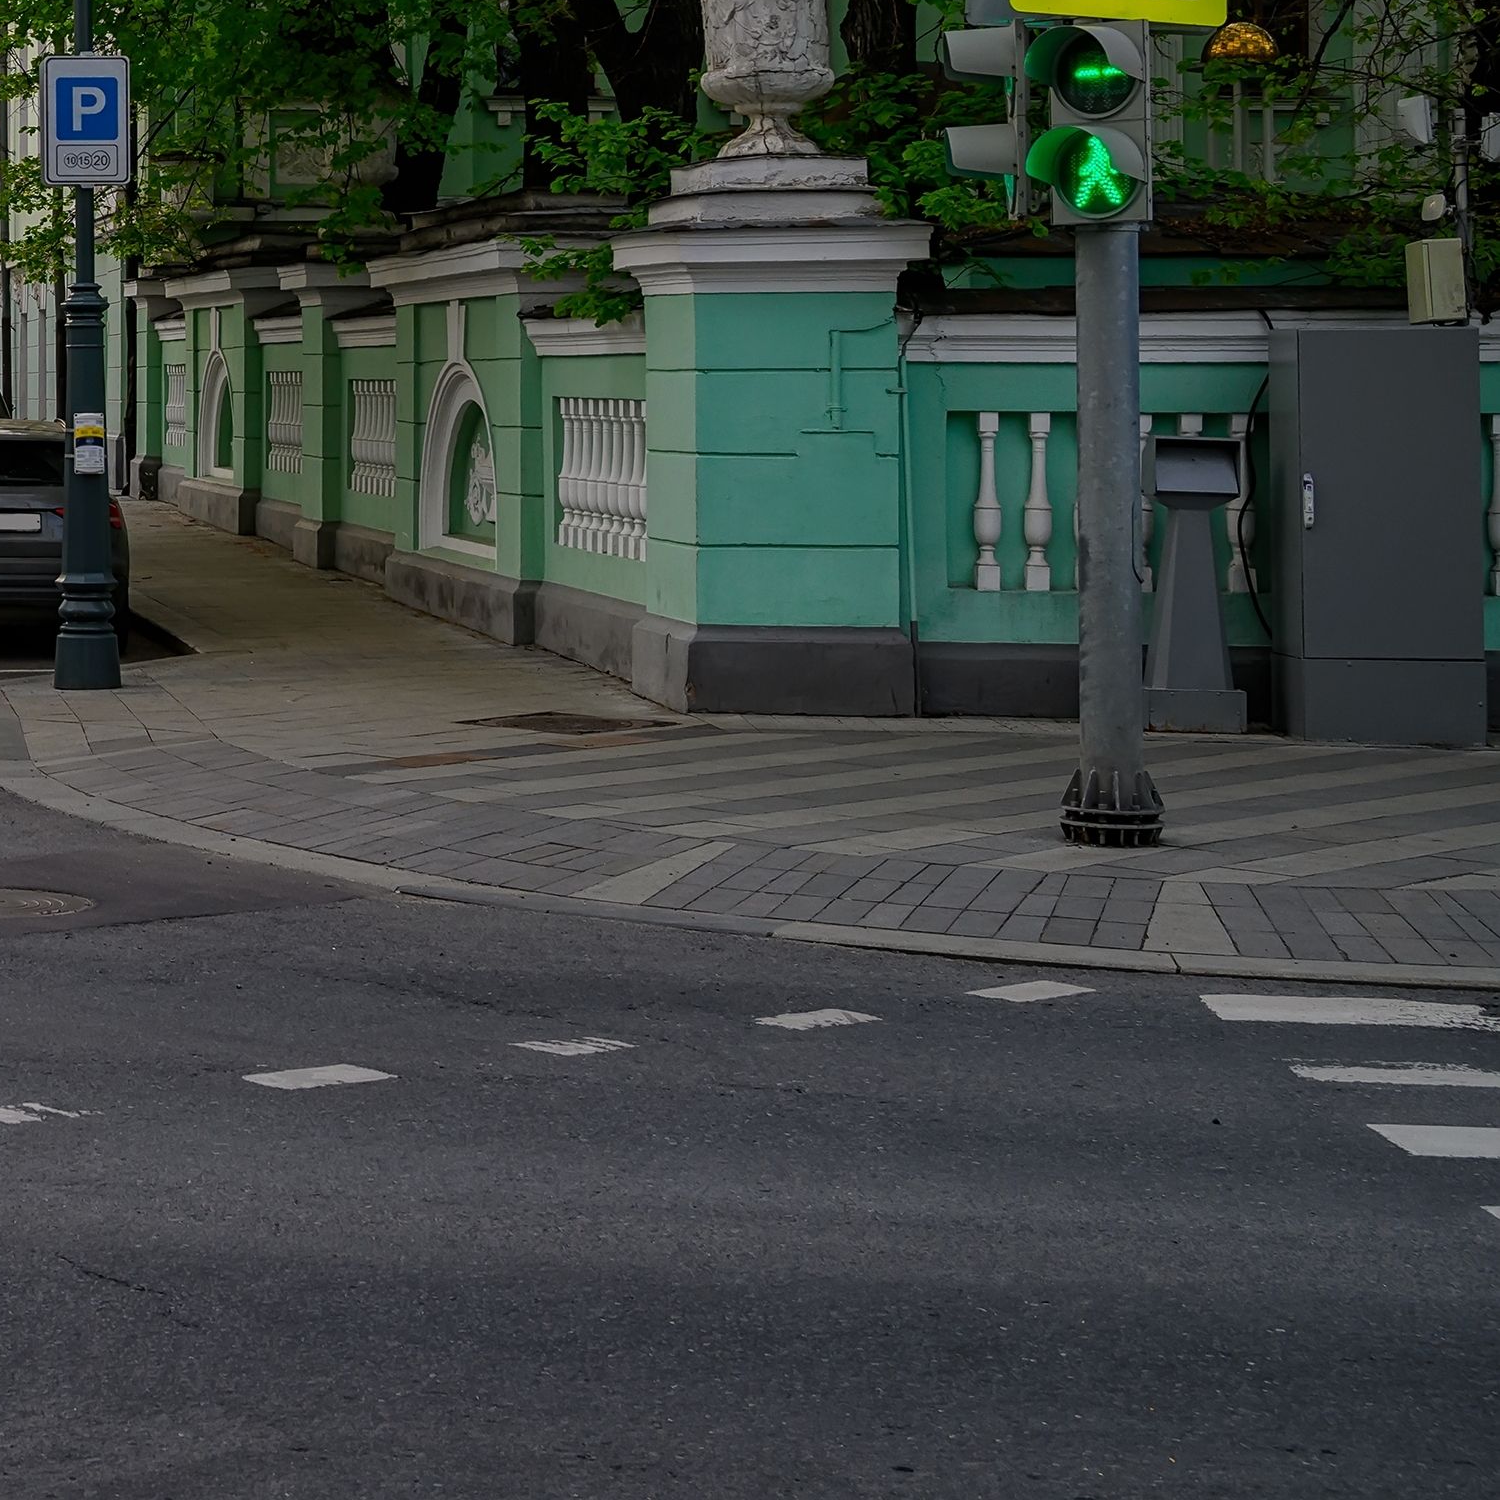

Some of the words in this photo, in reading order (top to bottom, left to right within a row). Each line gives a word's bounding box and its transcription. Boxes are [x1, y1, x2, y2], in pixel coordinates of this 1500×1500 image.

[72, 86, 106, 132] P
[66, 156, 77, 165] 10
[79, 155, 90, 166] 15
[93, 154, 108, 166] 20
